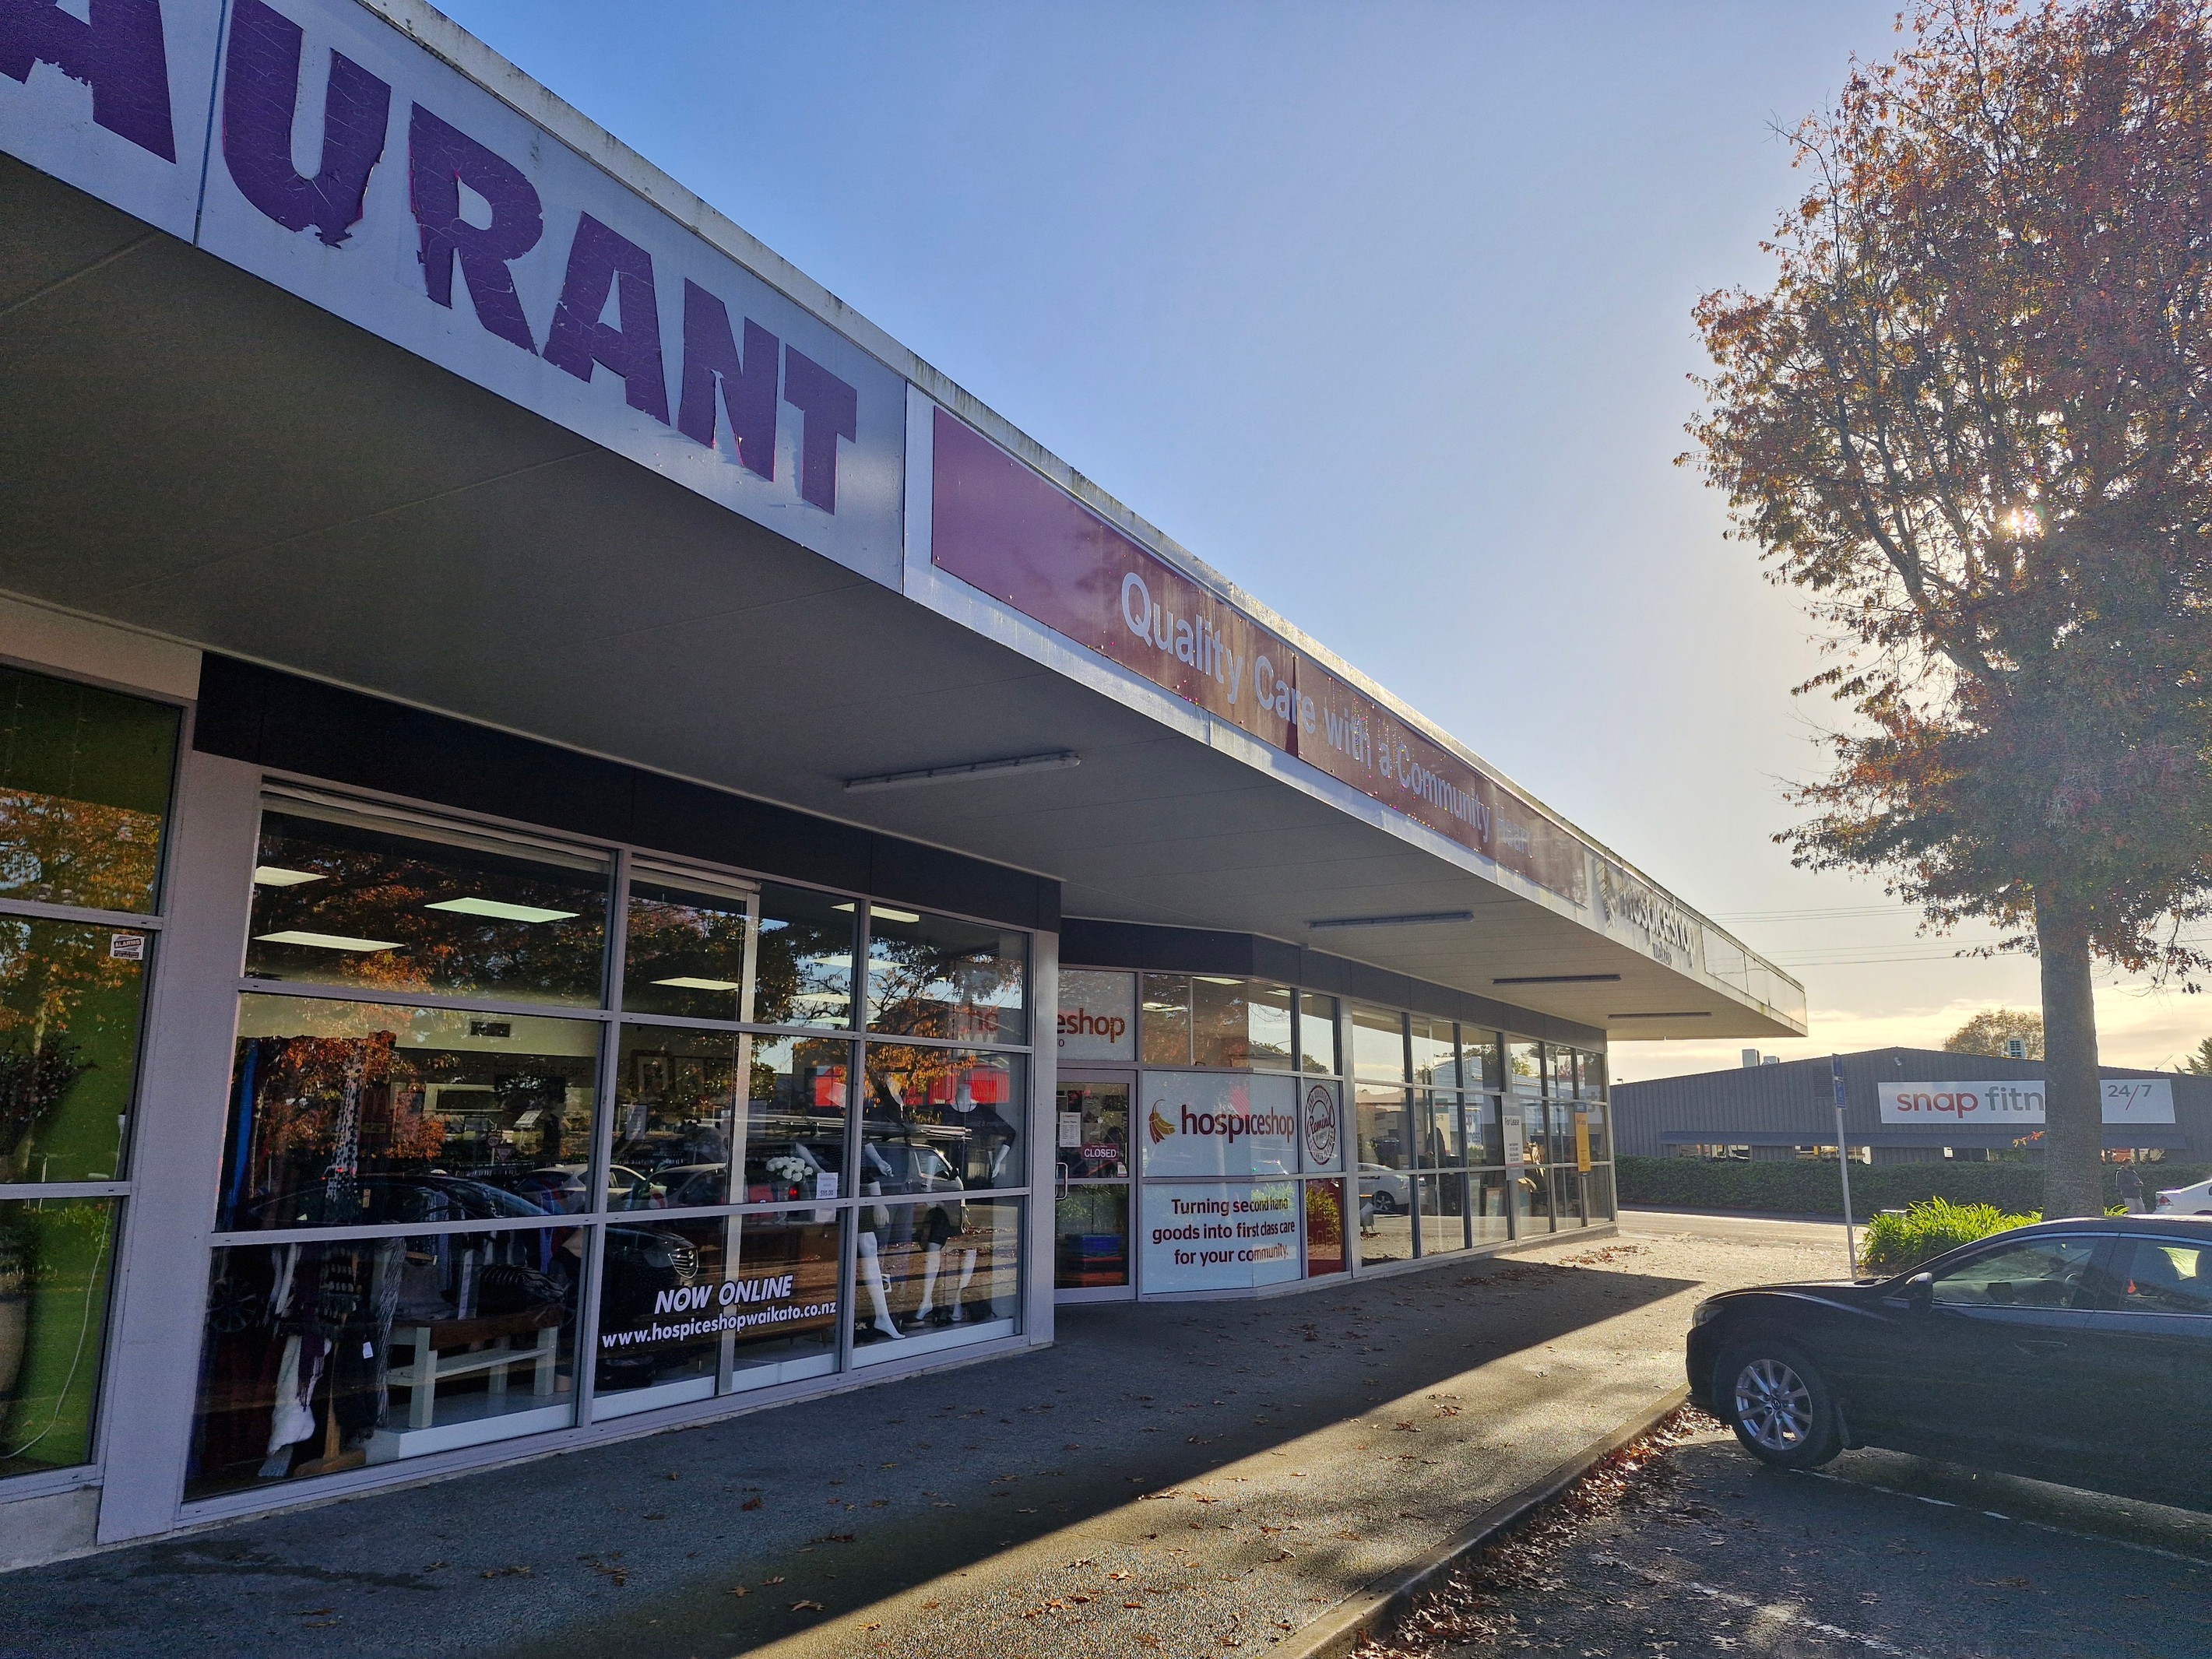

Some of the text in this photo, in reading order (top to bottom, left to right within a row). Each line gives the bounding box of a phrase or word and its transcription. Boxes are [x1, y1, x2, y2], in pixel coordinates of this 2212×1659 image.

[1121, 572, 1242, 705] Quality
[1254, 656, 1316, 734] Care
[1324, 705, 1372, 769] with
[1379, 743, 1391, 779] a
[1398, 743, 1490, 842] Community
[1896, 1091, 1978, 1119] snap
[2108, 1084, 2152, 1111] 24/7
[1181, 1104, 1295, 1144] hospiceshop
[1084, 1148, 1117, 1158] CLOSED
[1171, 1195, 1289, 1217] Turning second hand
[1152, 1220, 1296, 1245] goods into first class care
[1174, 1242, 1289, 1267] for your community.
[654, 1274, 794, 1315] NOW ONLINE
[602, 1300, 837, 1348] www.hospiceshopwaikato.co.nz
